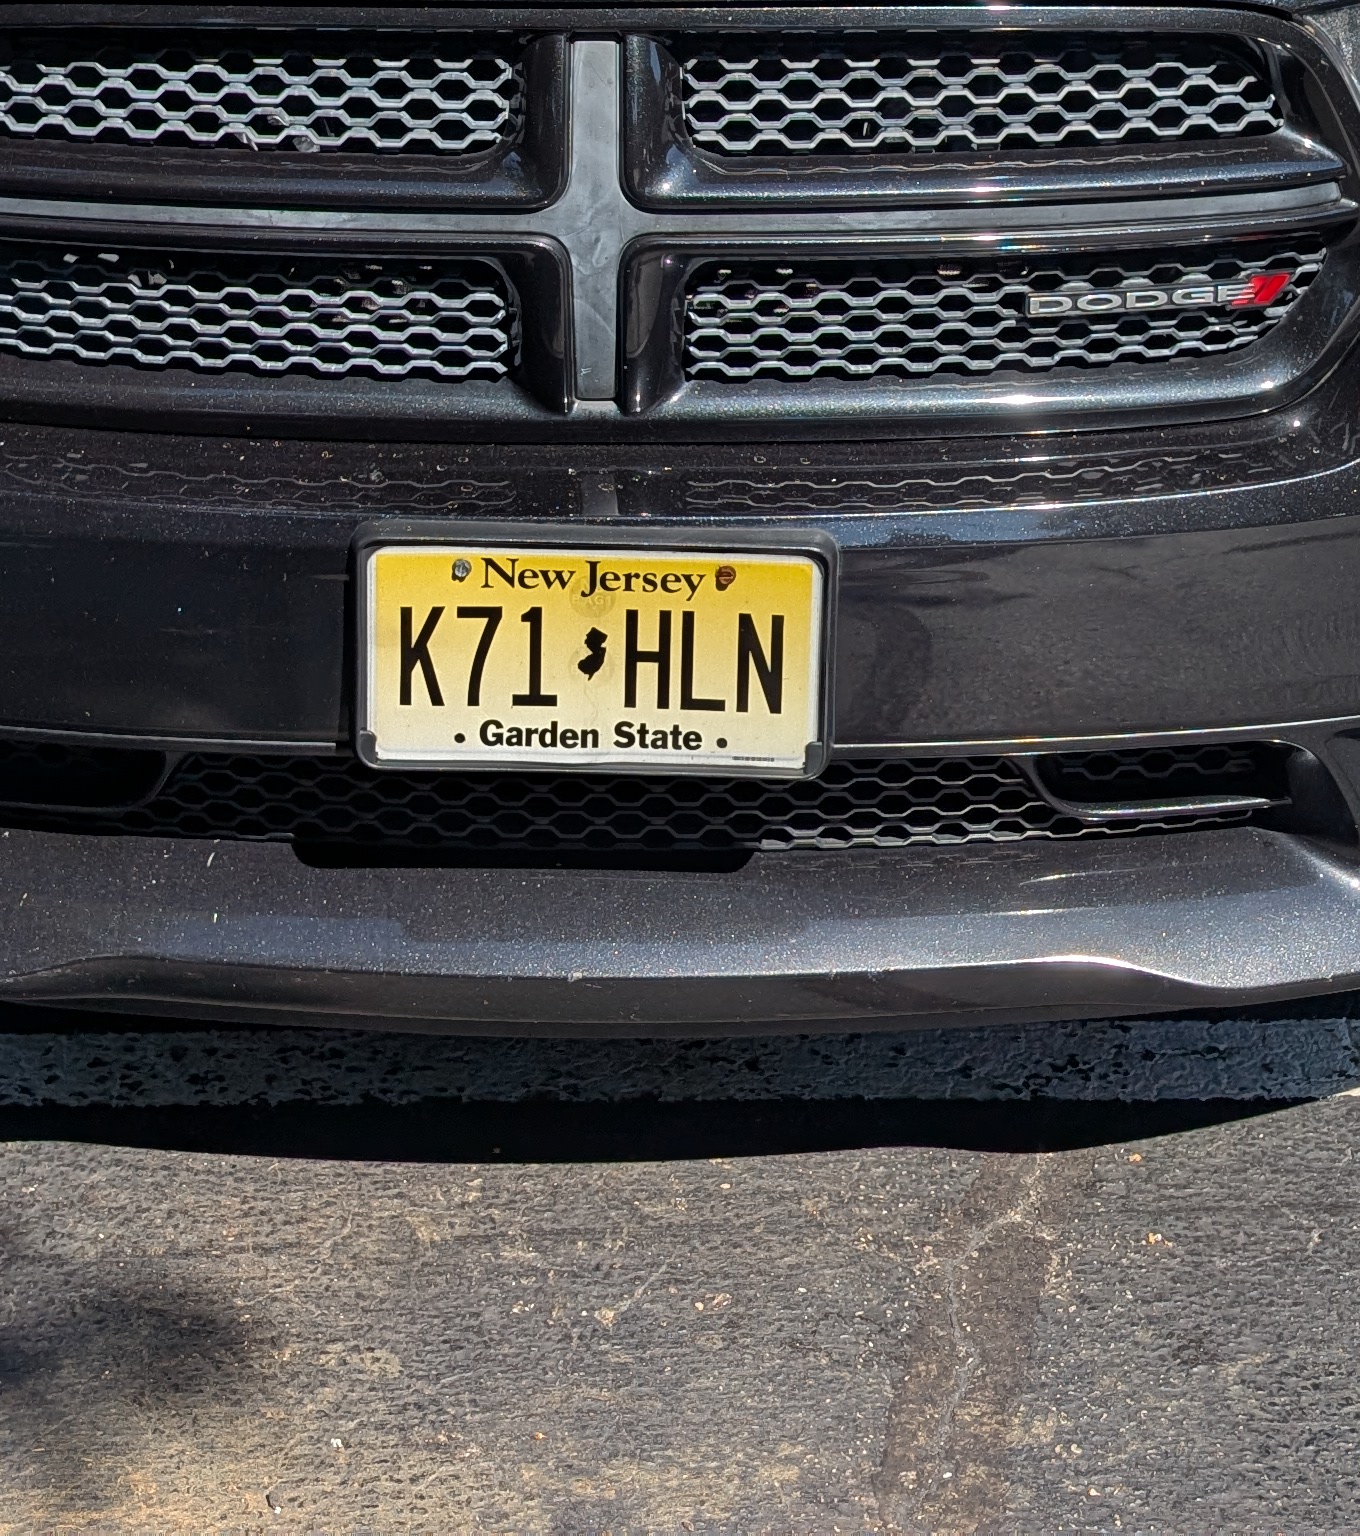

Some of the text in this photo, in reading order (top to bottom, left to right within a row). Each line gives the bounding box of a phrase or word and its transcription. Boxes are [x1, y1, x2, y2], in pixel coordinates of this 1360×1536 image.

[1030, 284, 1256, 314] DODGE
[481, 557, 706, 601] New Jersey
[399, 605, 785, 714] K71 HLN
[479, 719, 703, 751] Garden State
